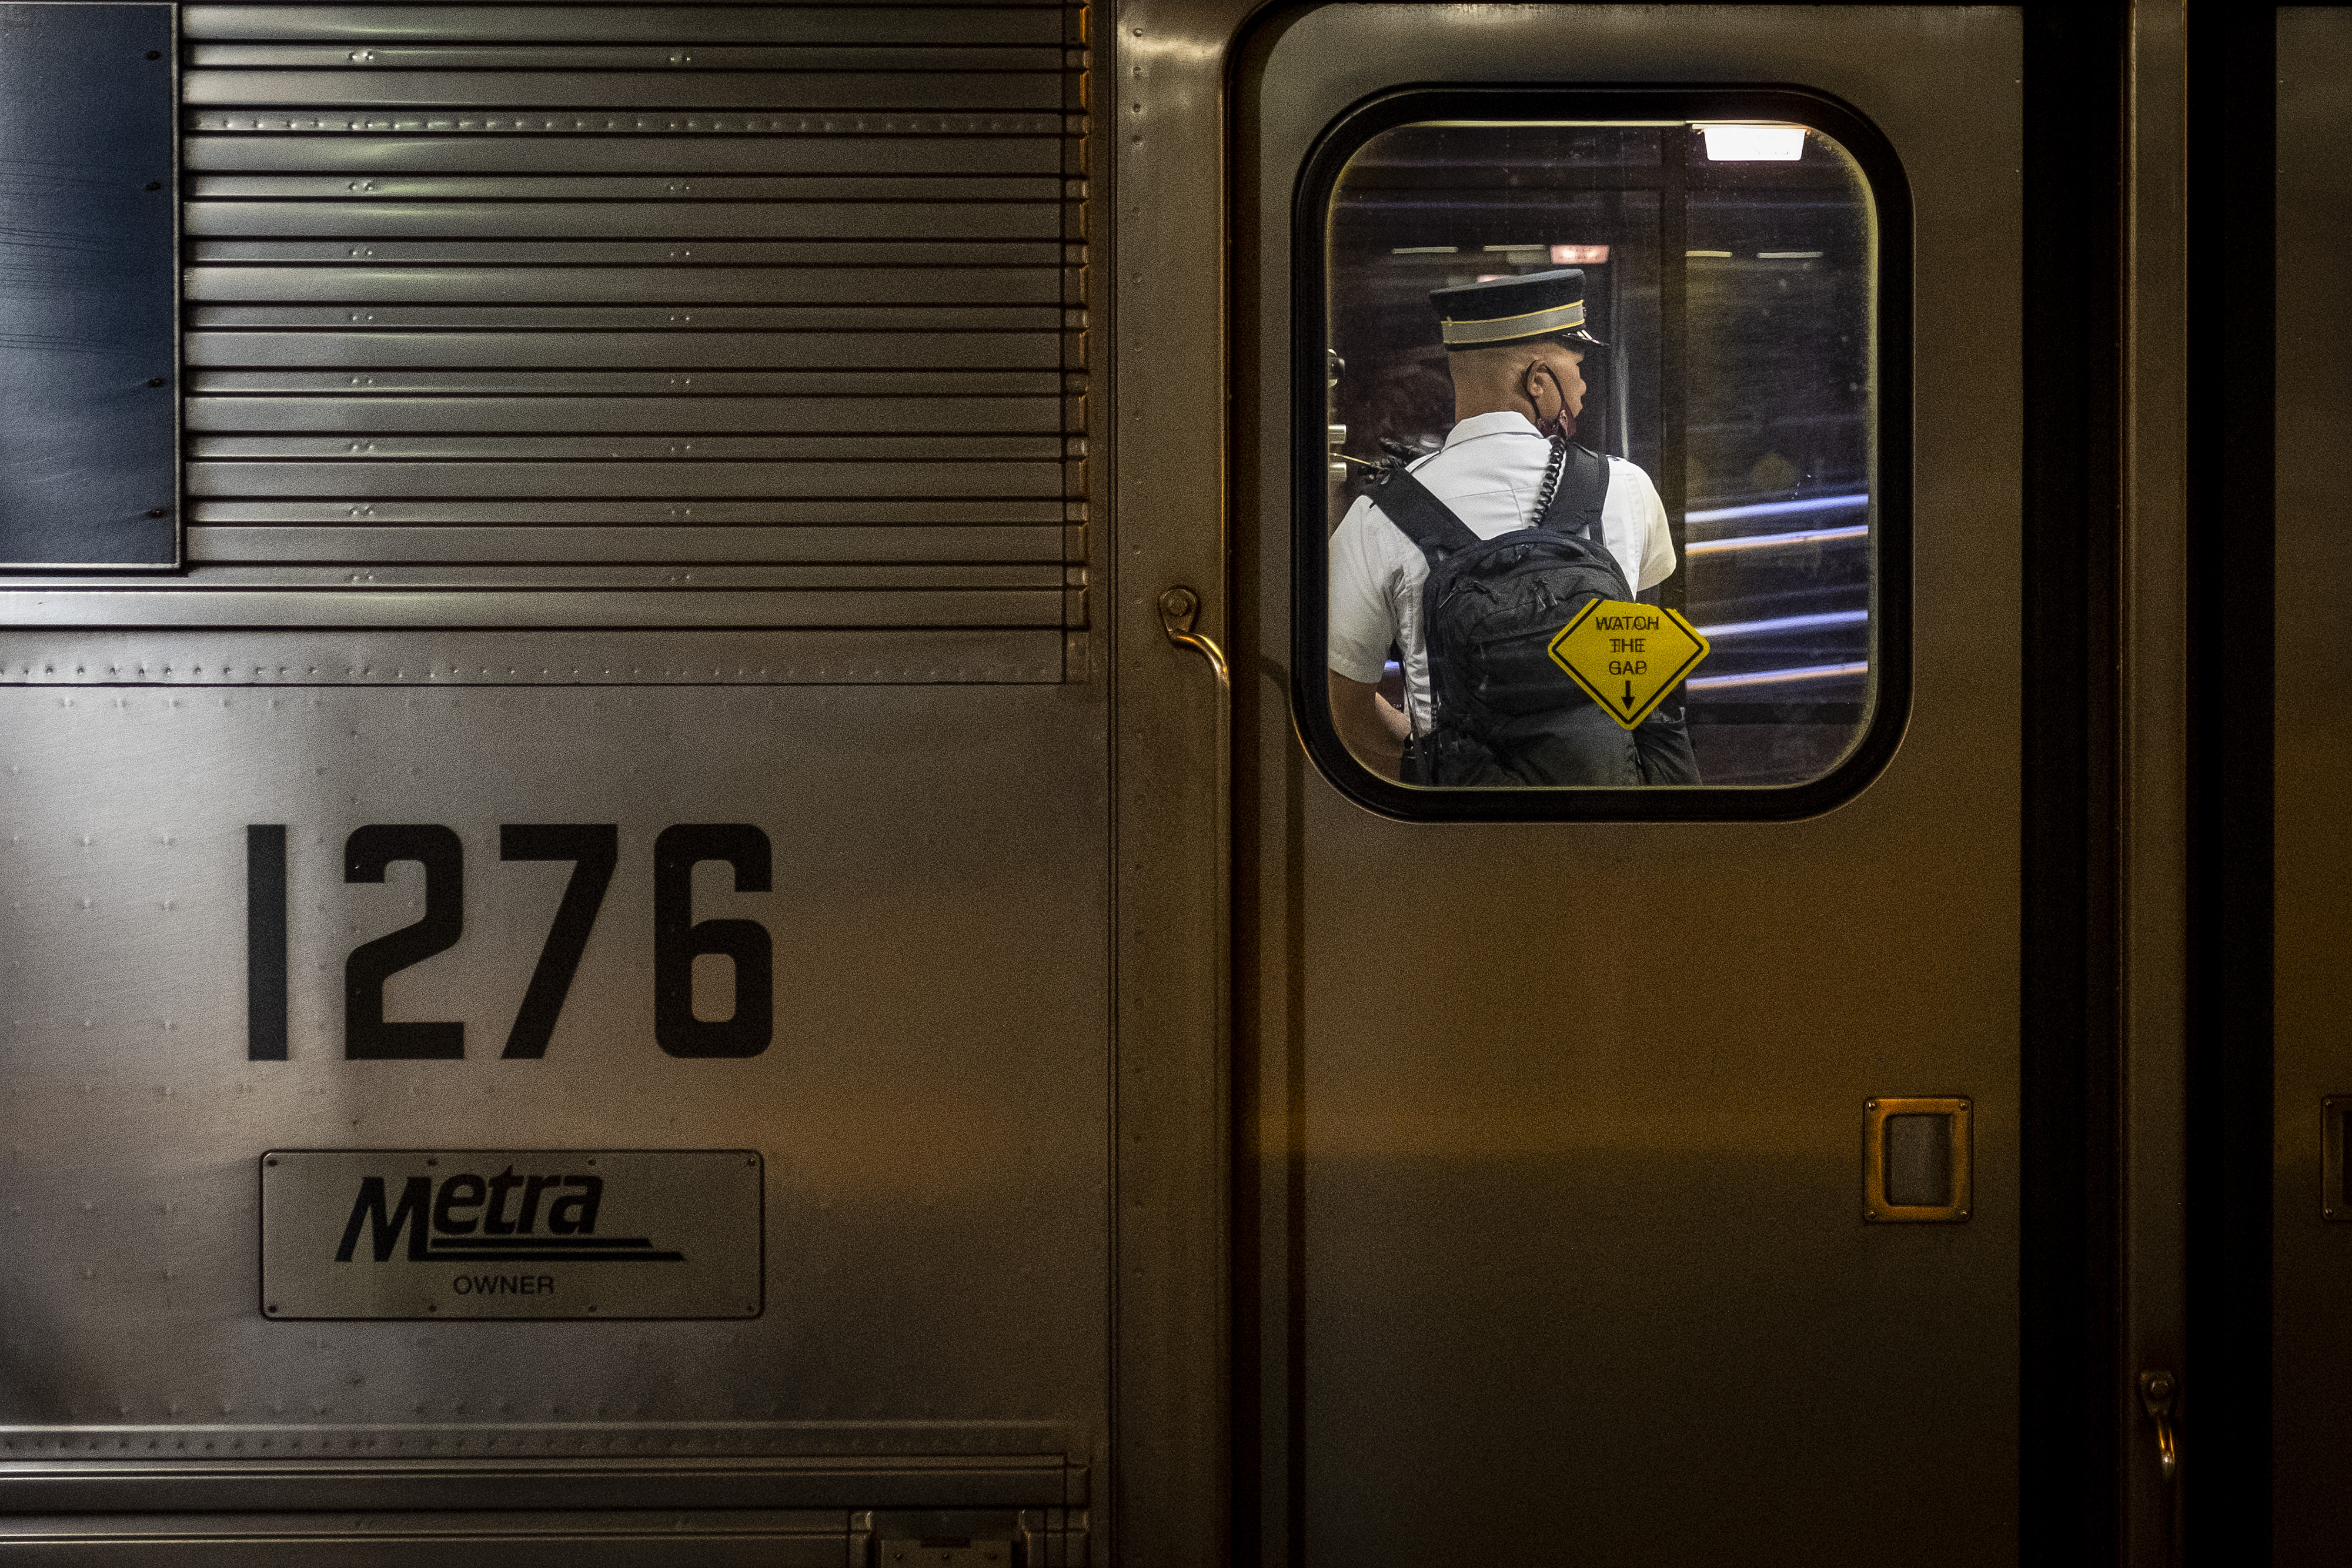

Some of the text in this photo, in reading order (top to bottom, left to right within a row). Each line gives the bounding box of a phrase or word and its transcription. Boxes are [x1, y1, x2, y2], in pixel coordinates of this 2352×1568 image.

[1595, 616, 1659, 631] WATCH
[1609, 638, 1646, 653] THE
[1608, 660, 1647, 676] GAP
[247, 823, 773, 1059] 1276
[333, 1165, 604, 1263] Metra
[453, 1275, 554, 1295] OWNER
